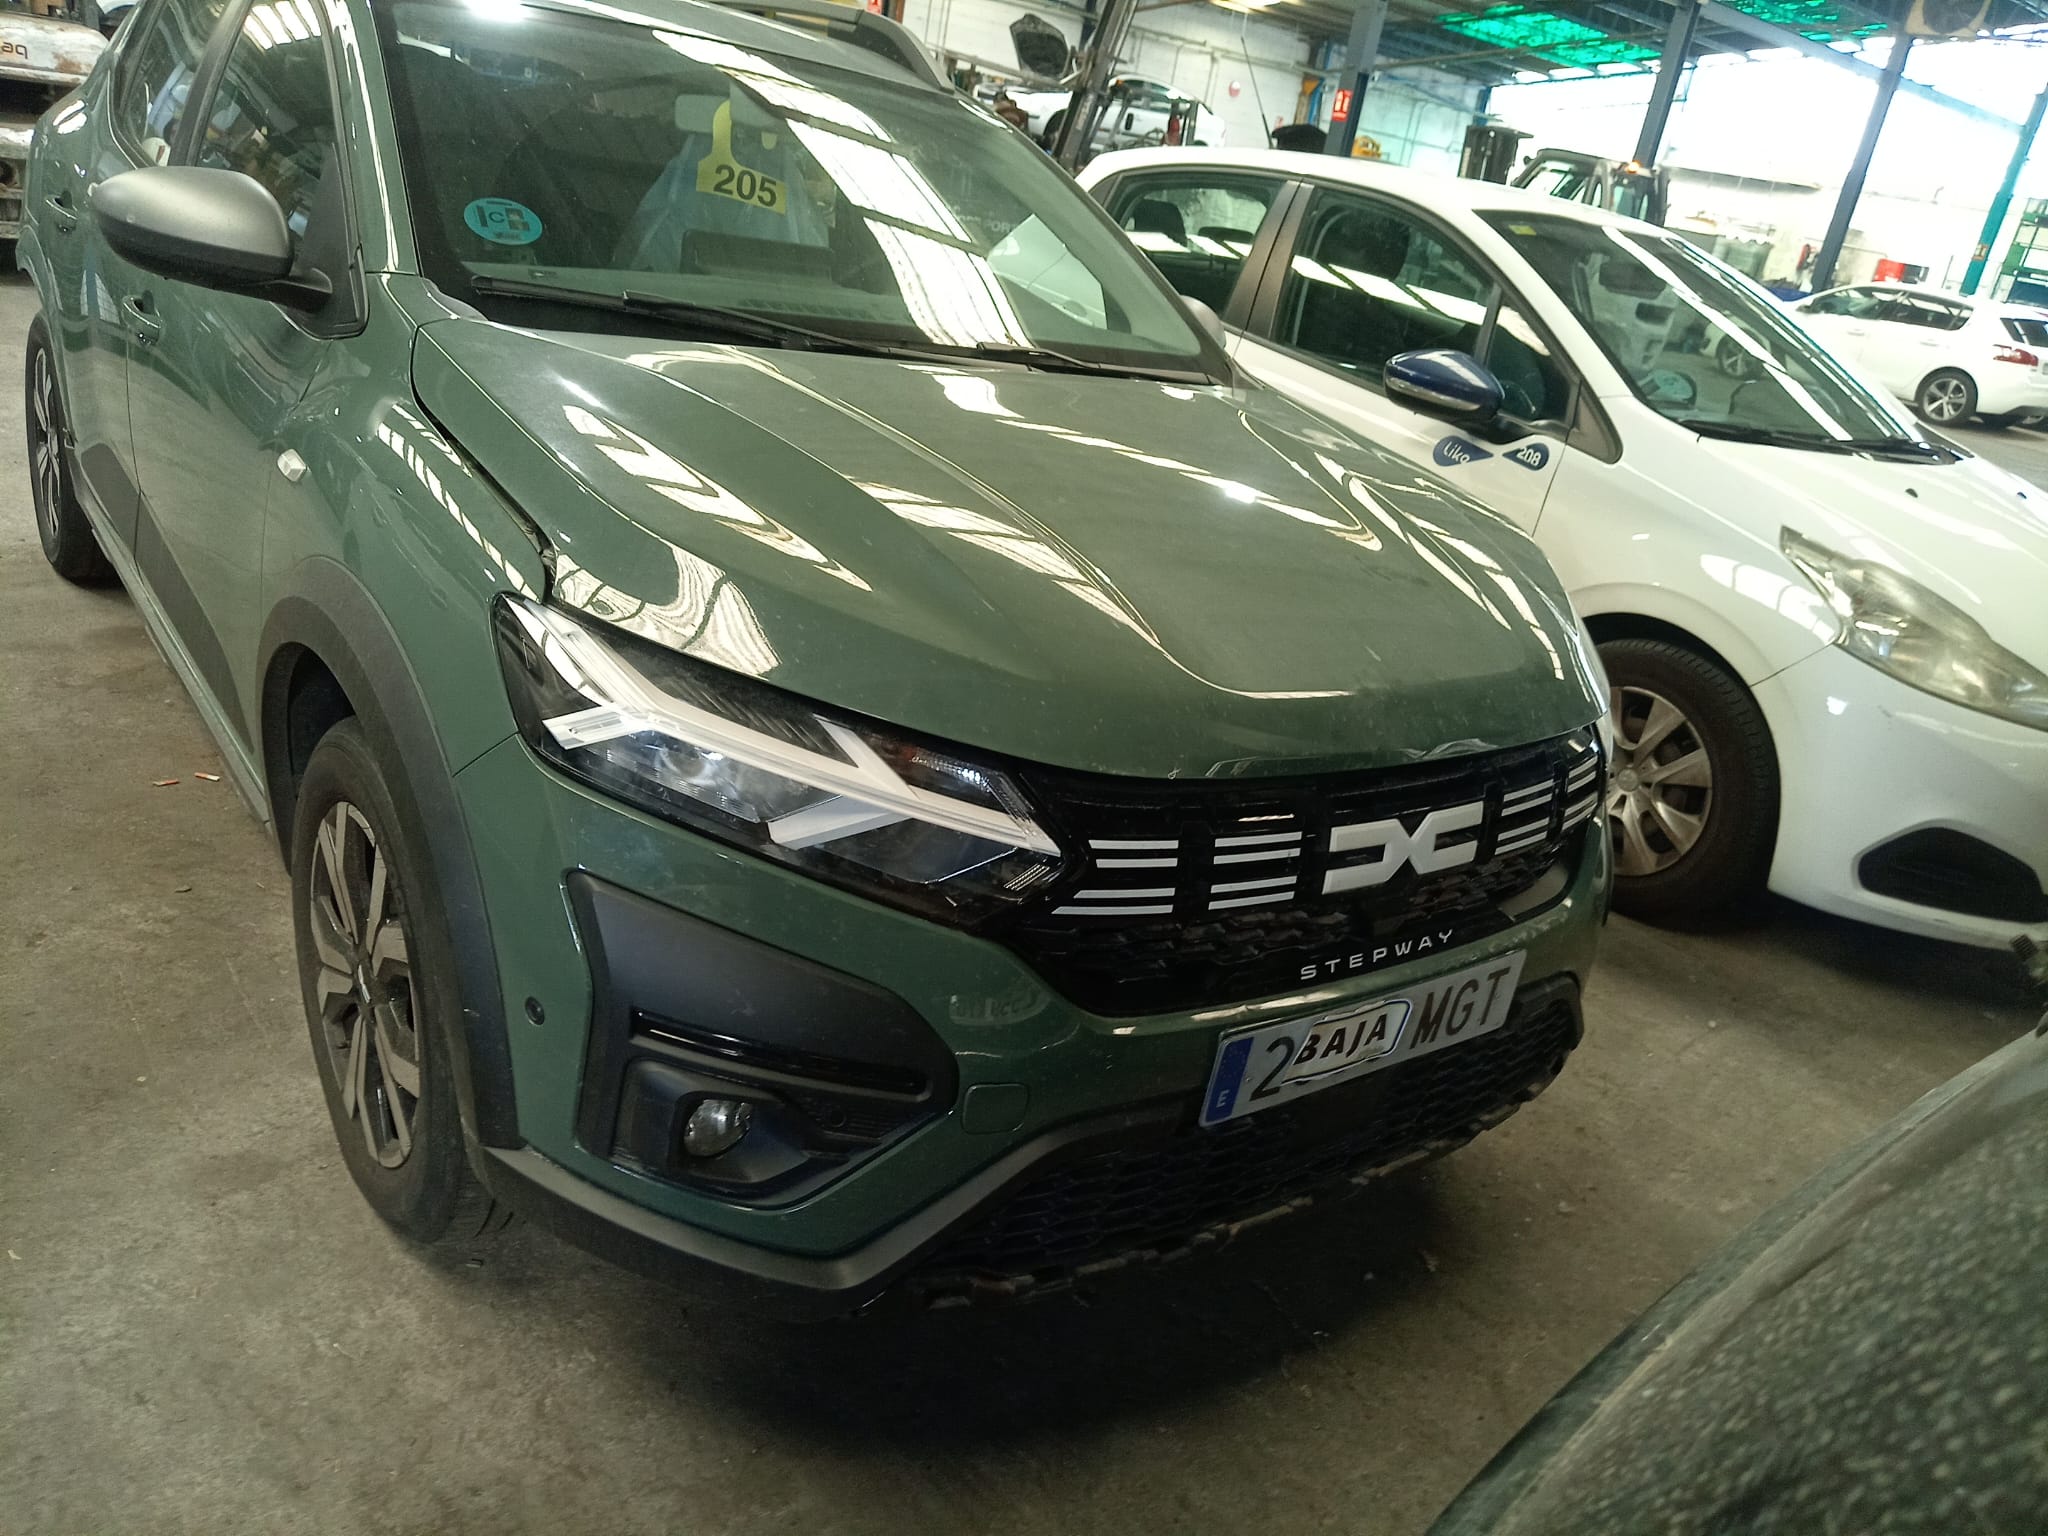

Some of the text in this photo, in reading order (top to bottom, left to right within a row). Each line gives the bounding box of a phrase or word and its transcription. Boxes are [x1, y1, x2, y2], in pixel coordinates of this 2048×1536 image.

[713, 164, 777, 207] 205
[1516, 446, 1542, 467] 208
[1300, 929, 1453, 980] STEPWAY
[1409, 966, 1511, 1049] MGT
[1293, 1013, 1388, 1066] BAJA
[1215, 1089, 1230, 1108] E
